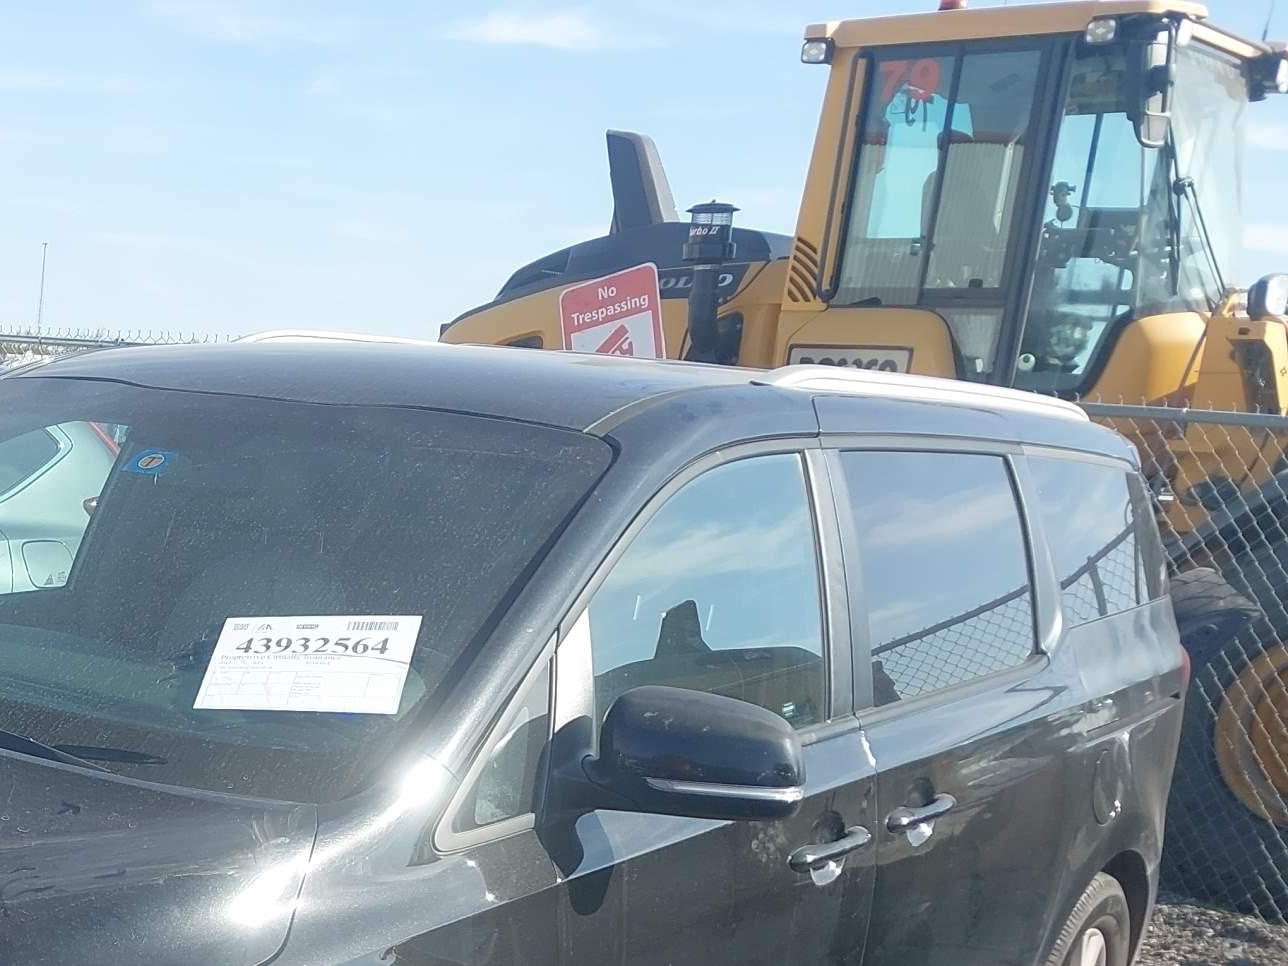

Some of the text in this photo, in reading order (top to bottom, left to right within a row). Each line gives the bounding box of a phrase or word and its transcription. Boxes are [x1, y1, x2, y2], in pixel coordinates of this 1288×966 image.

[598, 286, 617, 301] No
[571, 294, 649, 326] Trespassing
[235, 636, 390, 655] 43932564
